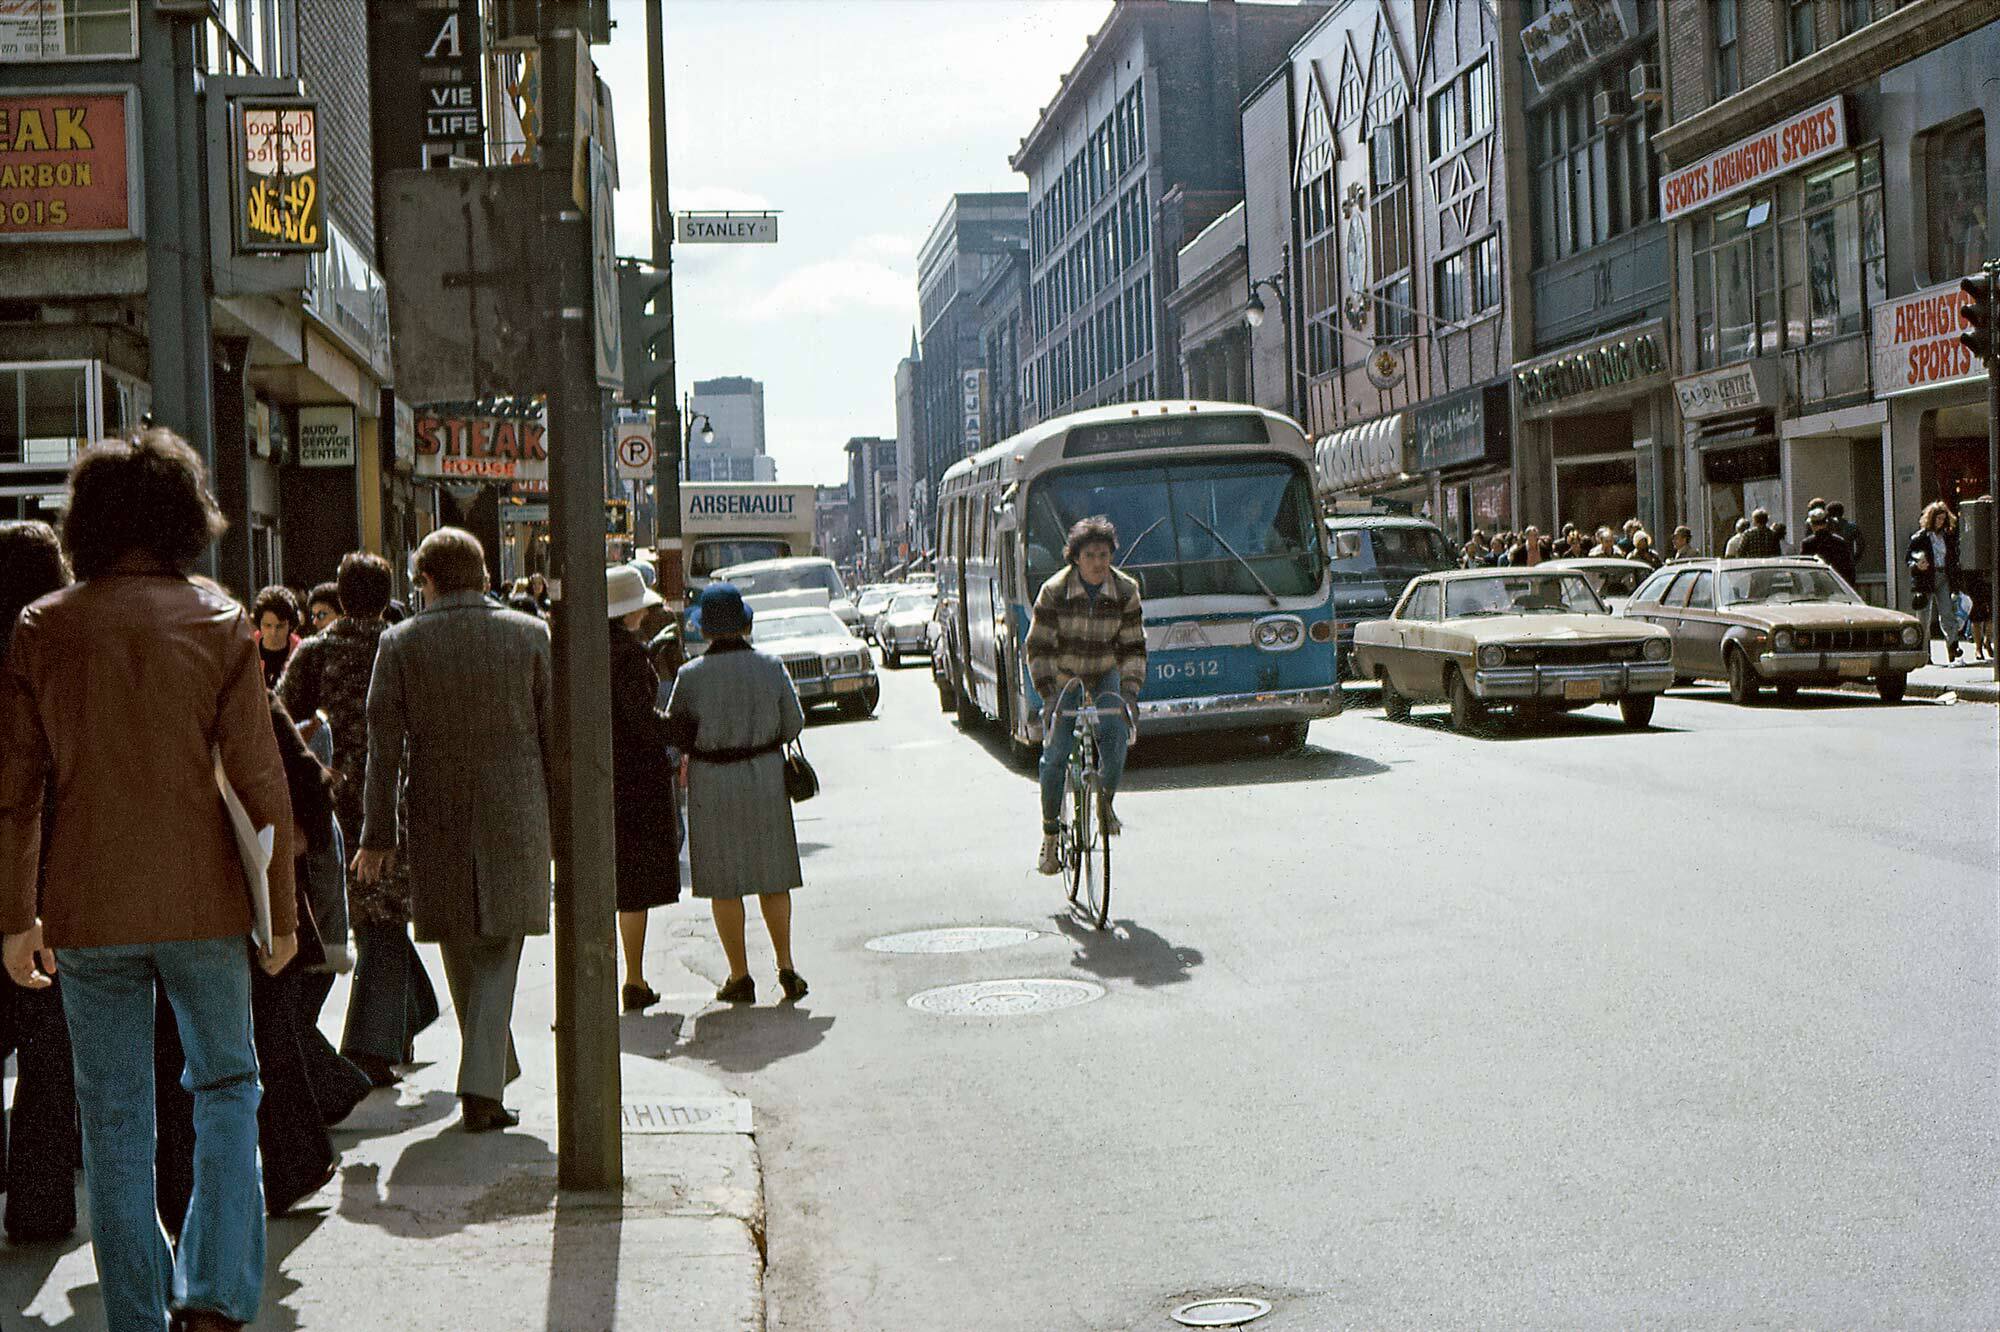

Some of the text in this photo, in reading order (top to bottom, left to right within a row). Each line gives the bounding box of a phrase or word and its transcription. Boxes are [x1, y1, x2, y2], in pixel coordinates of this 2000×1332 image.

[431, 87, 473, 106] VIE
[428, 116, 479, 136] LIFE
[1665, 165, 1709, 213] SPORTS
[1782, 105, 1837, 164] SPORTS
[686, 222, 756, 238] STANLEY
[1907, 336, 1972, 385] SPORTS
[302, 424, 338, 435] AUDIO
[415, 417, 547, 461] STEAK
[302, 435, 351, 448] SERVICE
[302, 448, 347, 460] CENTER
[442, 458, 516, 477] HOUSE
[689, 494, 796, 514] ARSENAULT
